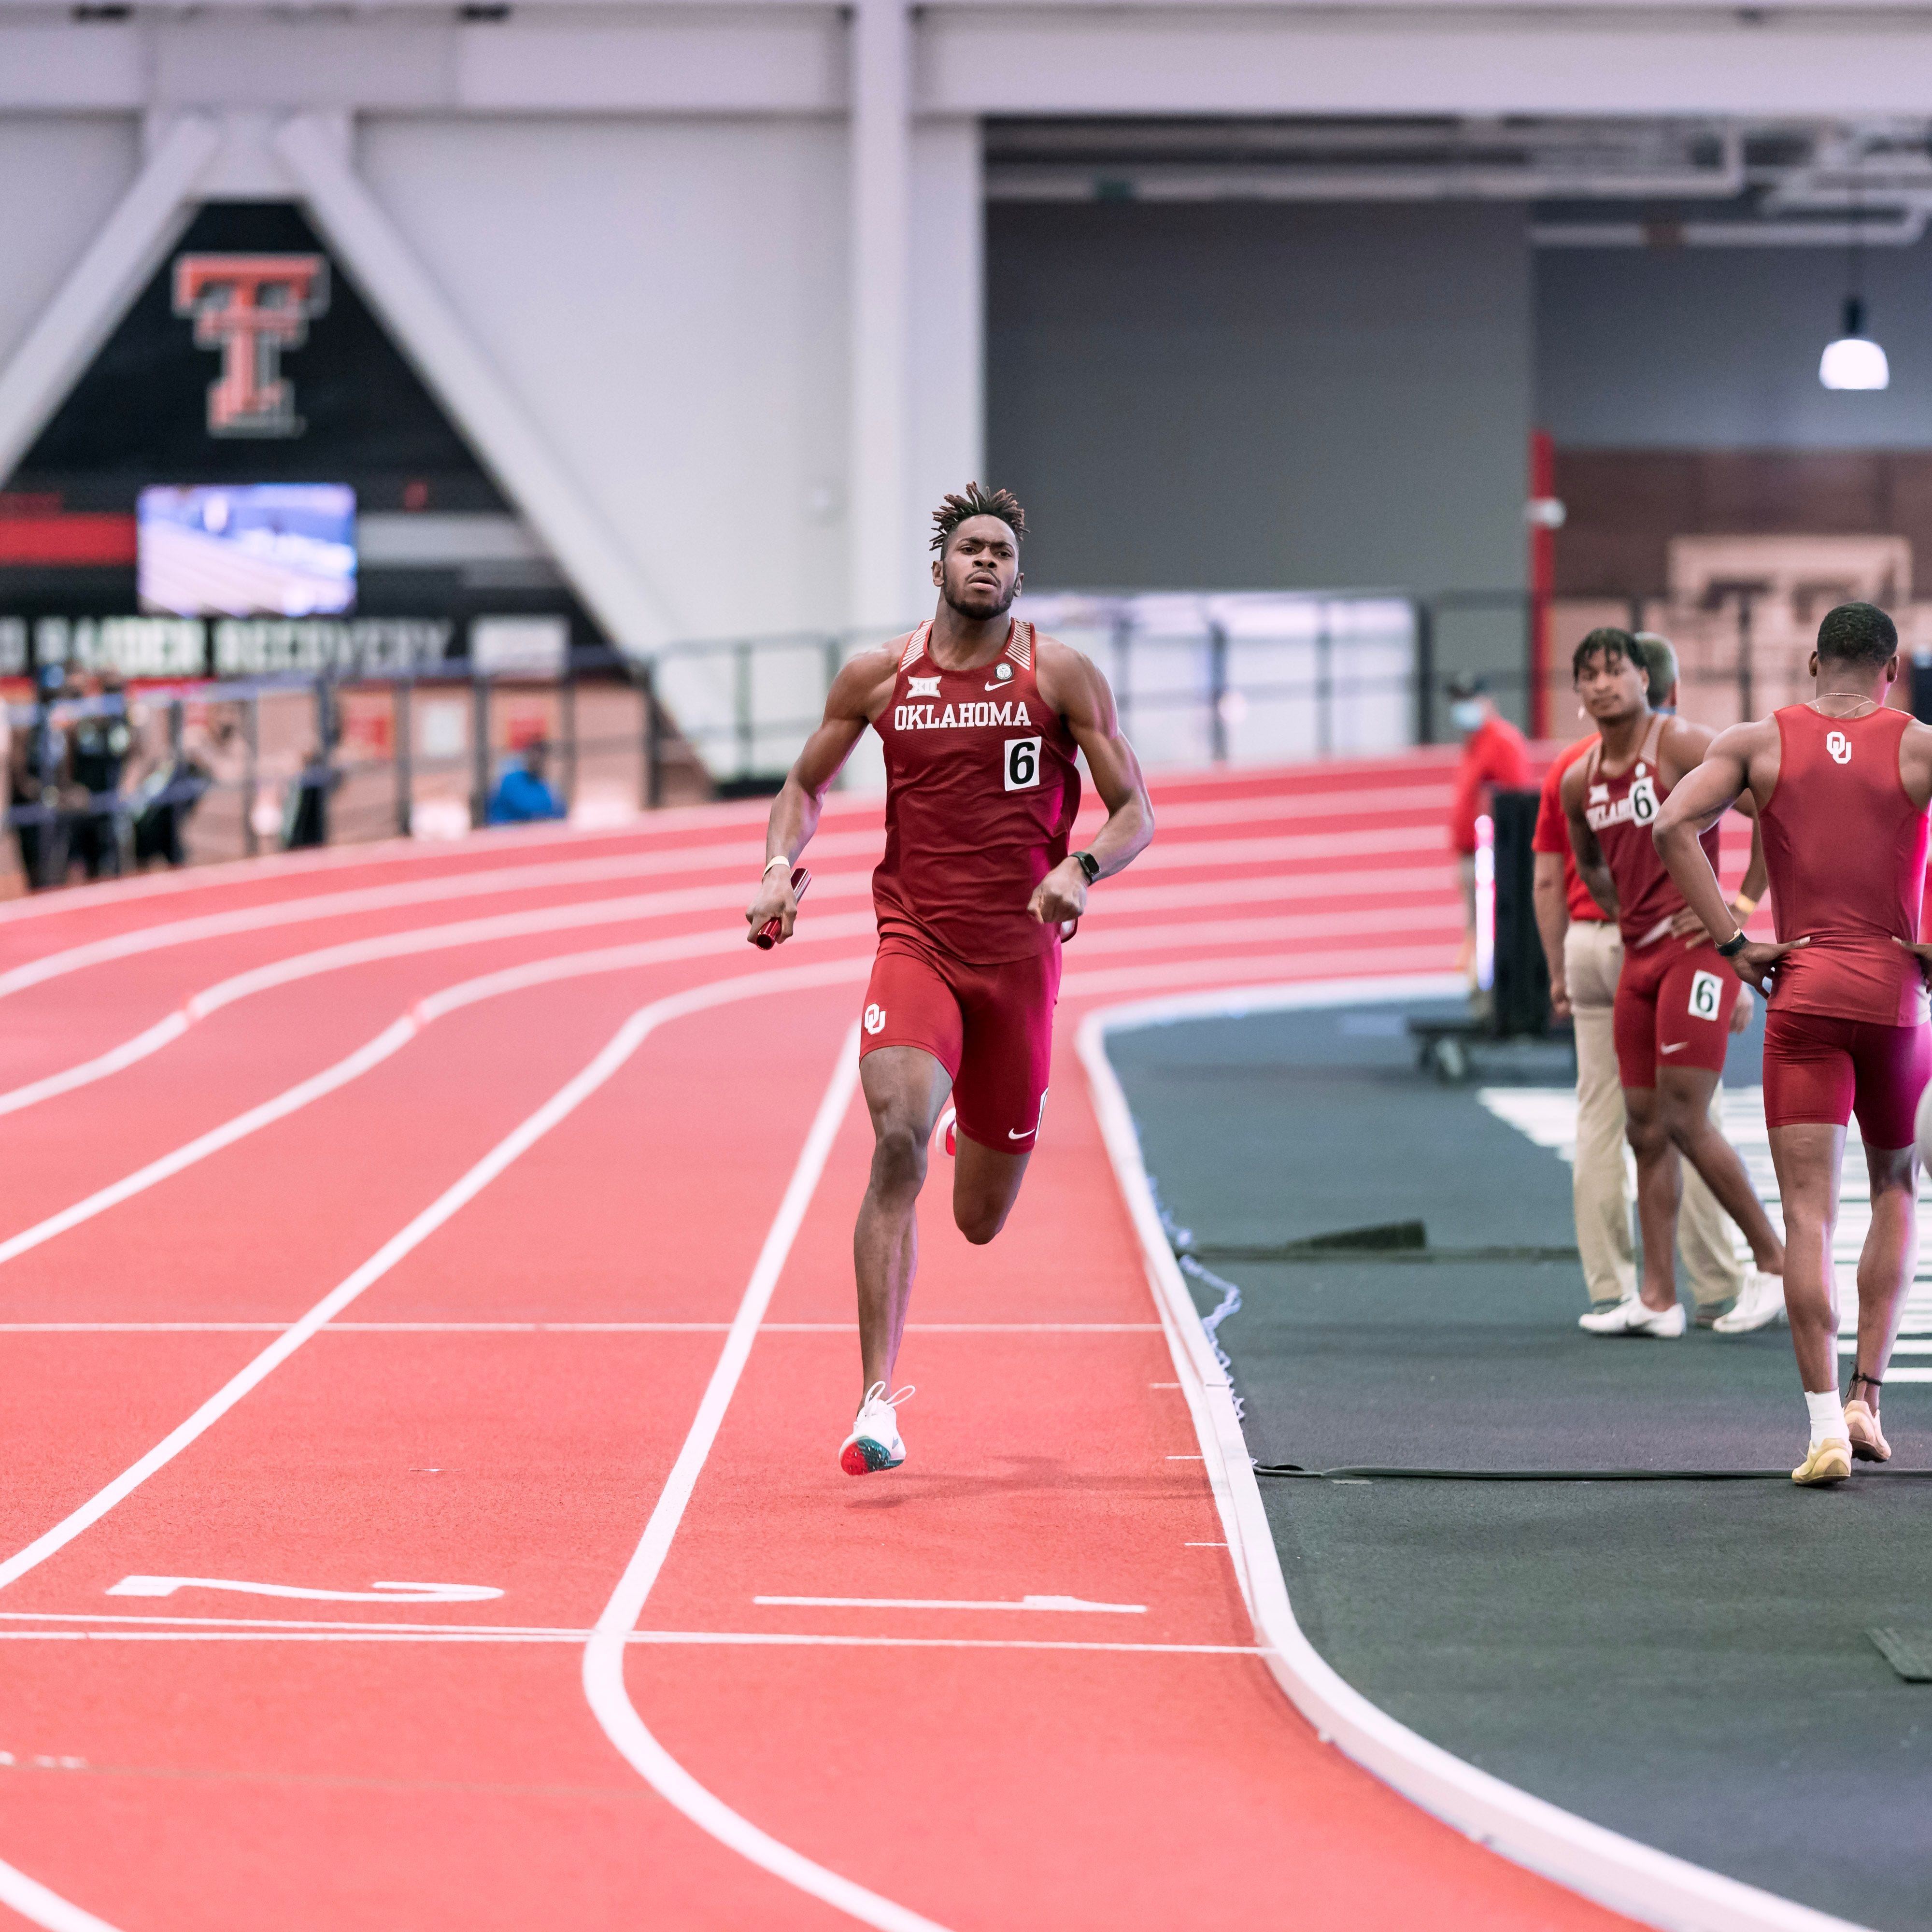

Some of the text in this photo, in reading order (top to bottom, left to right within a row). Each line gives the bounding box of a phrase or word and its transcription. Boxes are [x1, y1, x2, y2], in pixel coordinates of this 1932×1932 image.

[895, 702, 1031, 730] OKLAHOMA
[1009, 742, 1035, 784] 6
[1826, 731, 1851, 764] OU
[1634, 785, 1652, 820] 6
[1695, 979, 1715, 1013] 6
